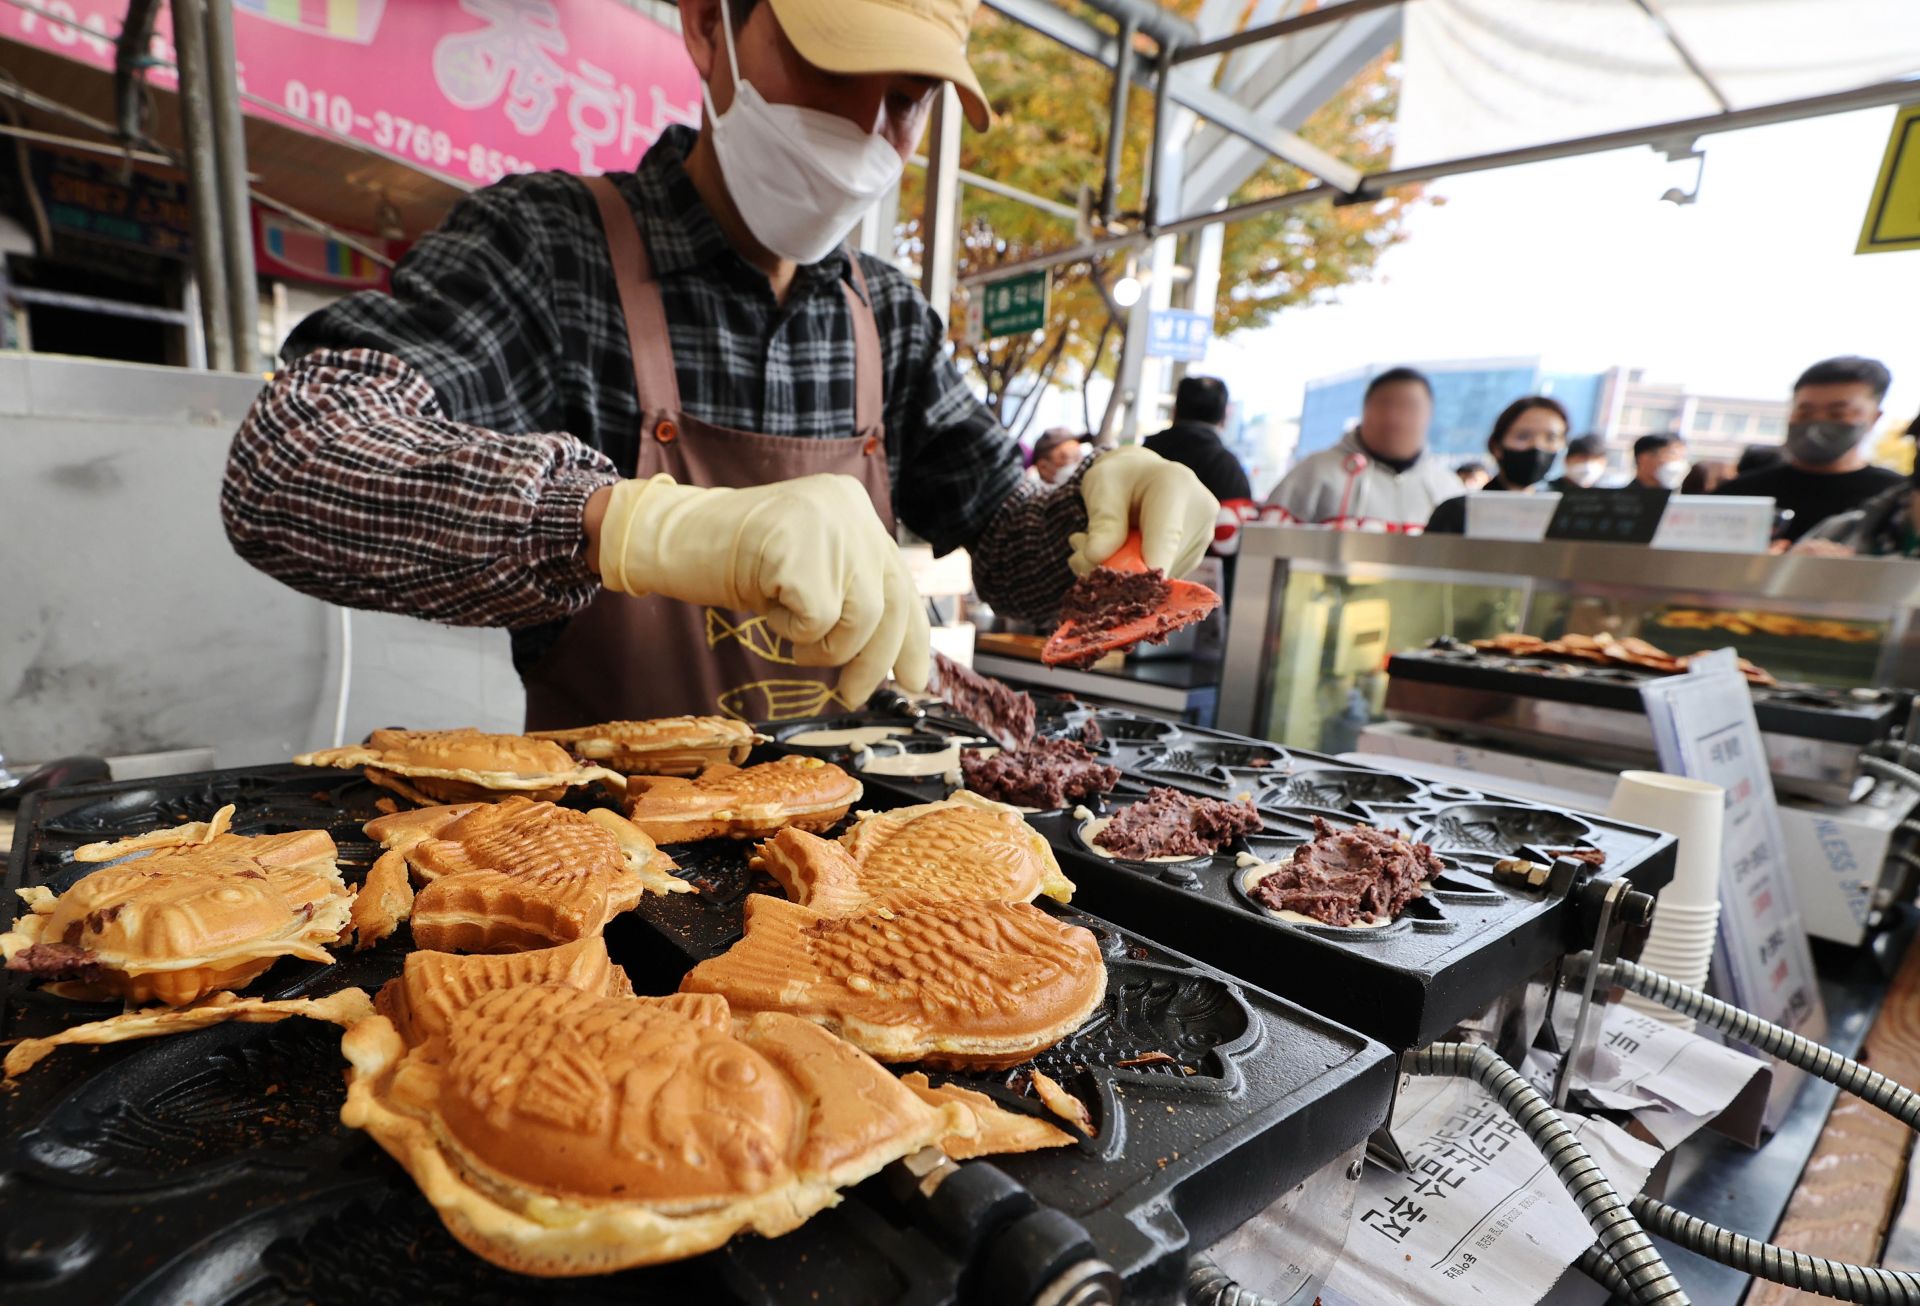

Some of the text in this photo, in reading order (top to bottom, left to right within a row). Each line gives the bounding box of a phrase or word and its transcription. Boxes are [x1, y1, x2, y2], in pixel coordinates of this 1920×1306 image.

[1441, 1113, 1523, 1173] 보드카도
[1405, 1159, 1467, 1199] 금수
[1360, 1196, 1428, 1245] 추진
[1443, 1253, 1477, 1280] 동아일보
